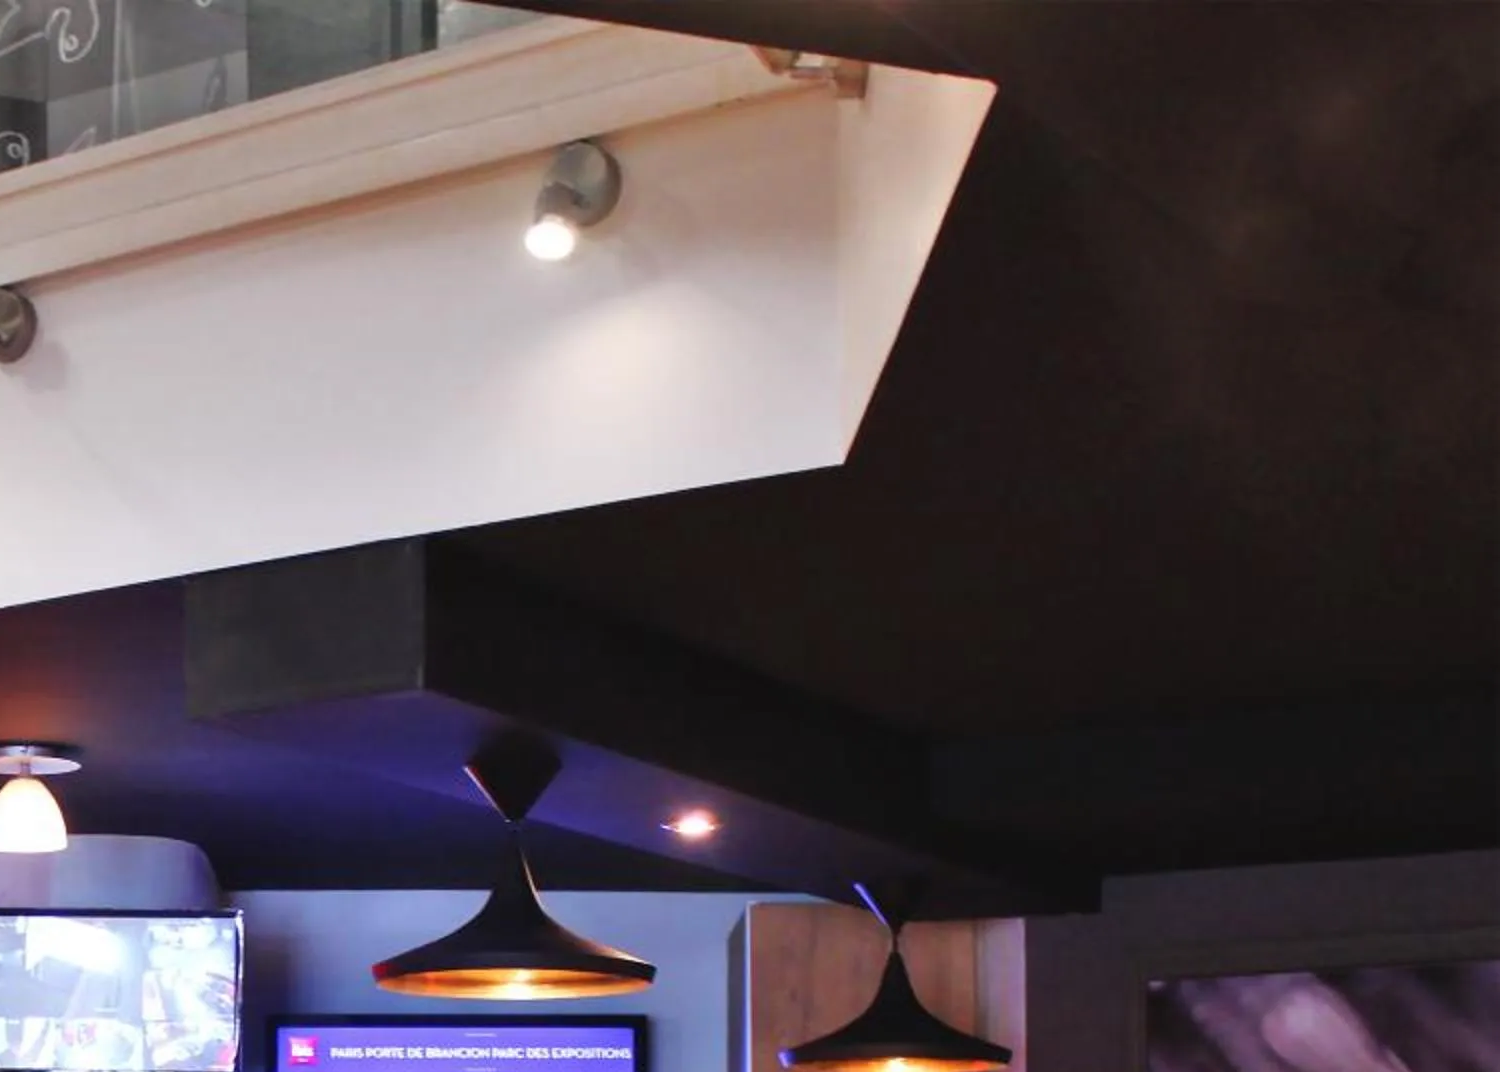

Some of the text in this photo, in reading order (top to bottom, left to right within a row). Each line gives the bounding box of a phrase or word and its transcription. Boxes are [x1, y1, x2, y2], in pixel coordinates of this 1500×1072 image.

[329, 1047, 363, 1060] PARIS
[365, 1047, 405, 1060] PORTE
[407, 1047, 423, 1060] DE
[425, 1047, 491, 1060] BRANCION
[492, 1047, 525, 1060] PARC
[526, 1047, 550, 1060] DES
[551, 1047, 632, 1060] EXPOSITIONS
